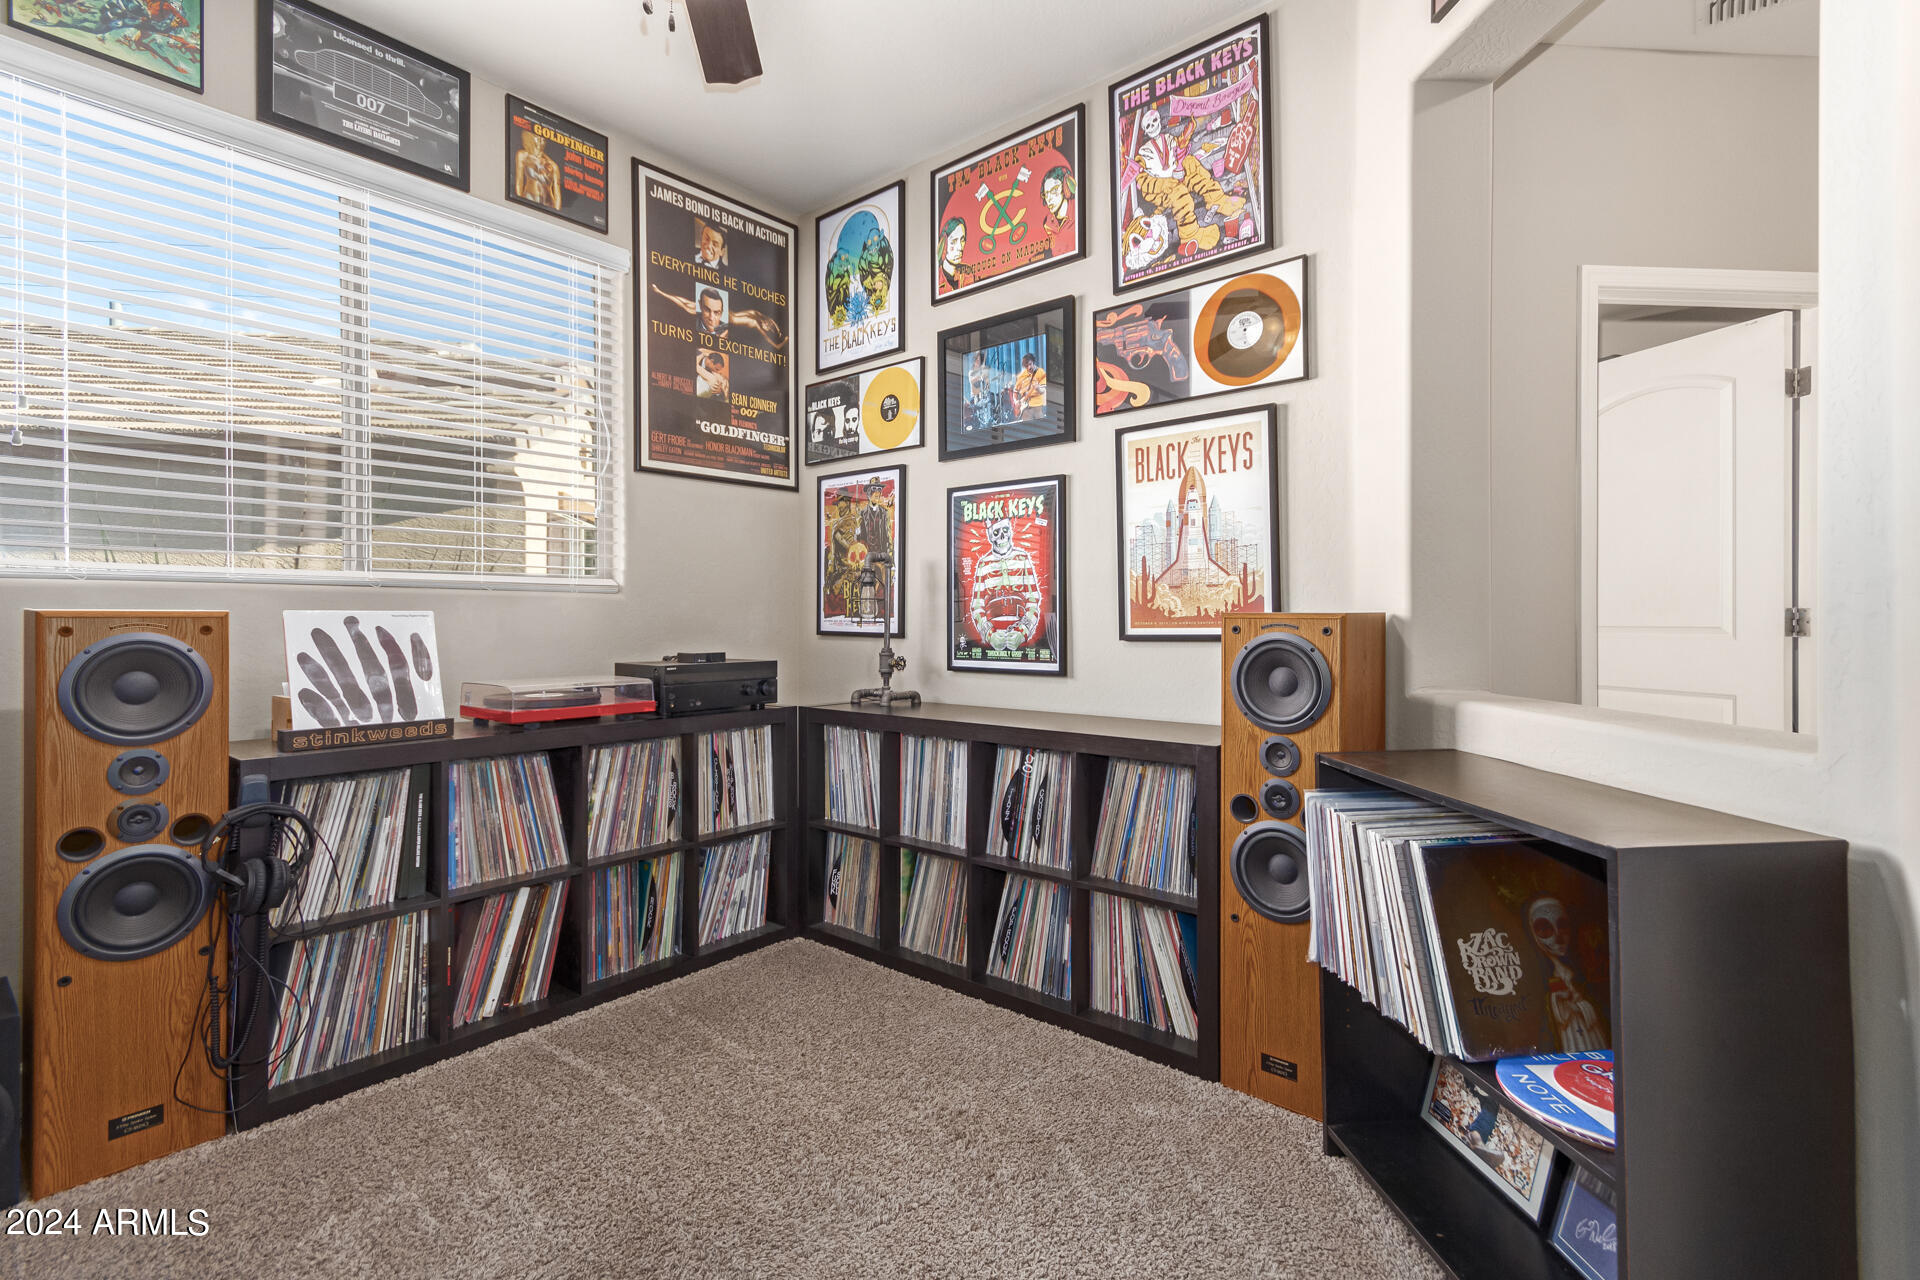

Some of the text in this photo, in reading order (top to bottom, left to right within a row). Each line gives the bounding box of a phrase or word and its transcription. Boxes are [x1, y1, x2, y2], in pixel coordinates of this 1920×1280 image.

[333, 30, 406, 68] Licensed to thrill.
[1122, 37, 1253, 111] THE BLACK KEYS
[356, 93, 387, 114] 007
[533, 123, 605, 162] GOLDFINGER
[978, 145, 1020, 179] BLACK
[1027, 125, 1063, 158] KEYS
[650, 184, 786, 249] JAMES BOND IS BACK IN ACTION!
[1001, 251, 1012, 265] ON
[651, 251, 786, 307] EVERYTHING HE TOUCHES
[651, 319, 787, 367] TURNS TO EXCITEMENT!
[823, 317, 896, 355] THE BLACK KEYS
[731, 392, 748, 407] SEAN
[749, 396, 777, 413] CONNERY
[740, 407, 759, 418] 007
[811, 401, 827, 411] BLACK
[827, 396, 841, 408] KEYS
[651, 430, 667, 444] GERT
[667, 434, 688, 447] FROBE
[705, 440, 725, 453] HONOR
[724, 443, 753, 457] BLACKMAN
[1135, 431, 1253, 484] BLACK KEYS
[963, 500, 1004, 522] BLACK
[1008, 494, 1044, 518] KEYS
[292, 721, 448, 749] stinkweeds
[1034, 788, 1045, 841] COUNTRY
[646, 895, 656, 929] ROCK
[1458, 927, 1514, 956] ZAC
[1461, 949, 1521, 971] BROWN
[1468, 964, 1523, 995] BAND
[1511, 1074, 1577, 1114] NOTE
